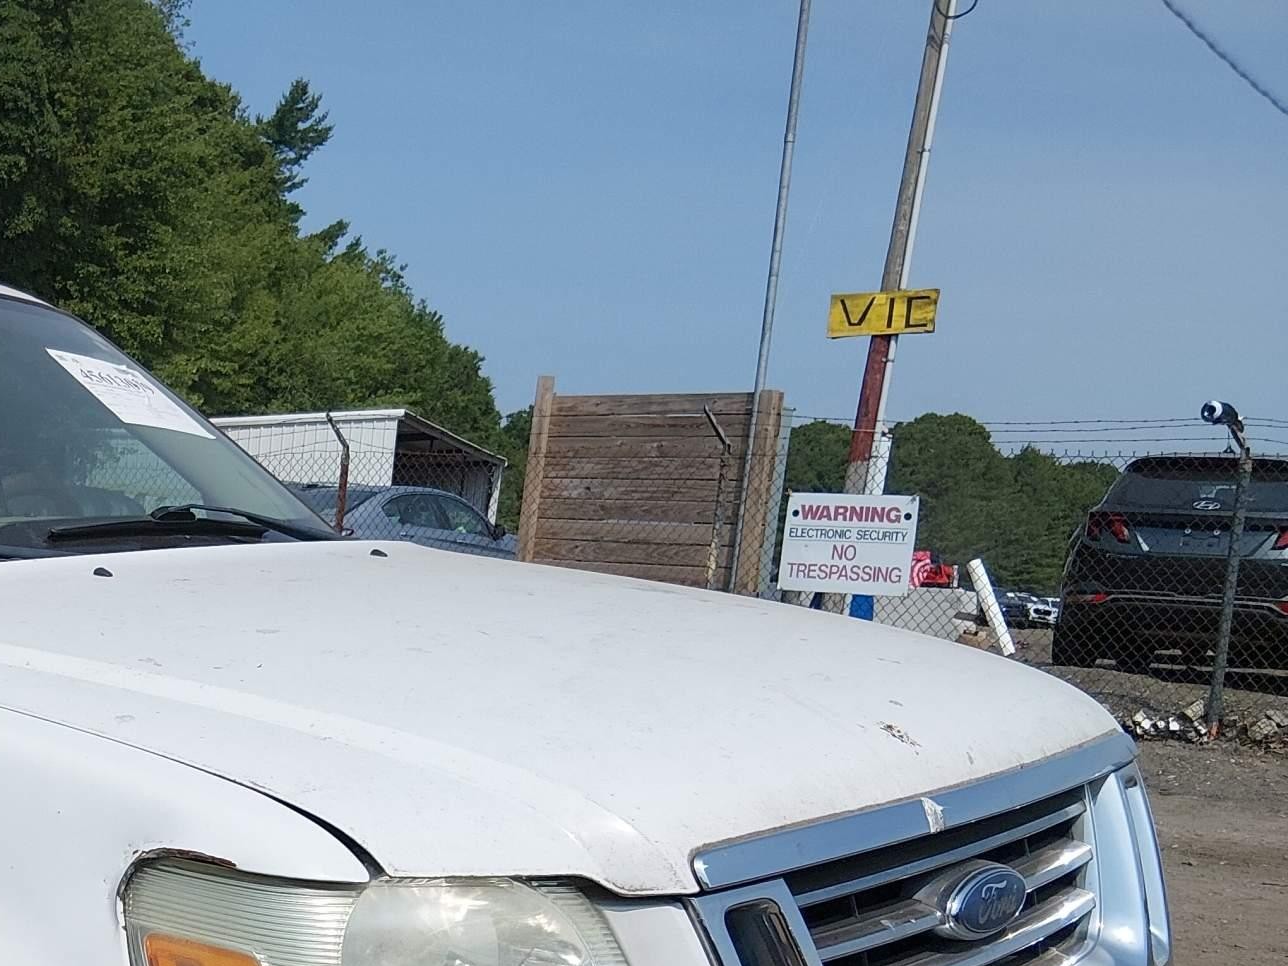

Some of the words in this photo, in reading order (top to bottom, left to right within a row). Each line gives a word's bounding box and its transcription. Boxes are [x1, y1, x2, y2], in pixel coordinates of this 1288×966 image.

[800, 504, 902, 523] WARNING
[789, 527, 852, 539] ELECTRONIC
[856, 529, 908, 542] SECURITY
[831, 544, 857, 561] NO
[787, 563, 902, 583] TRESPASSING
[978, 880, 1017, 924] Ford
